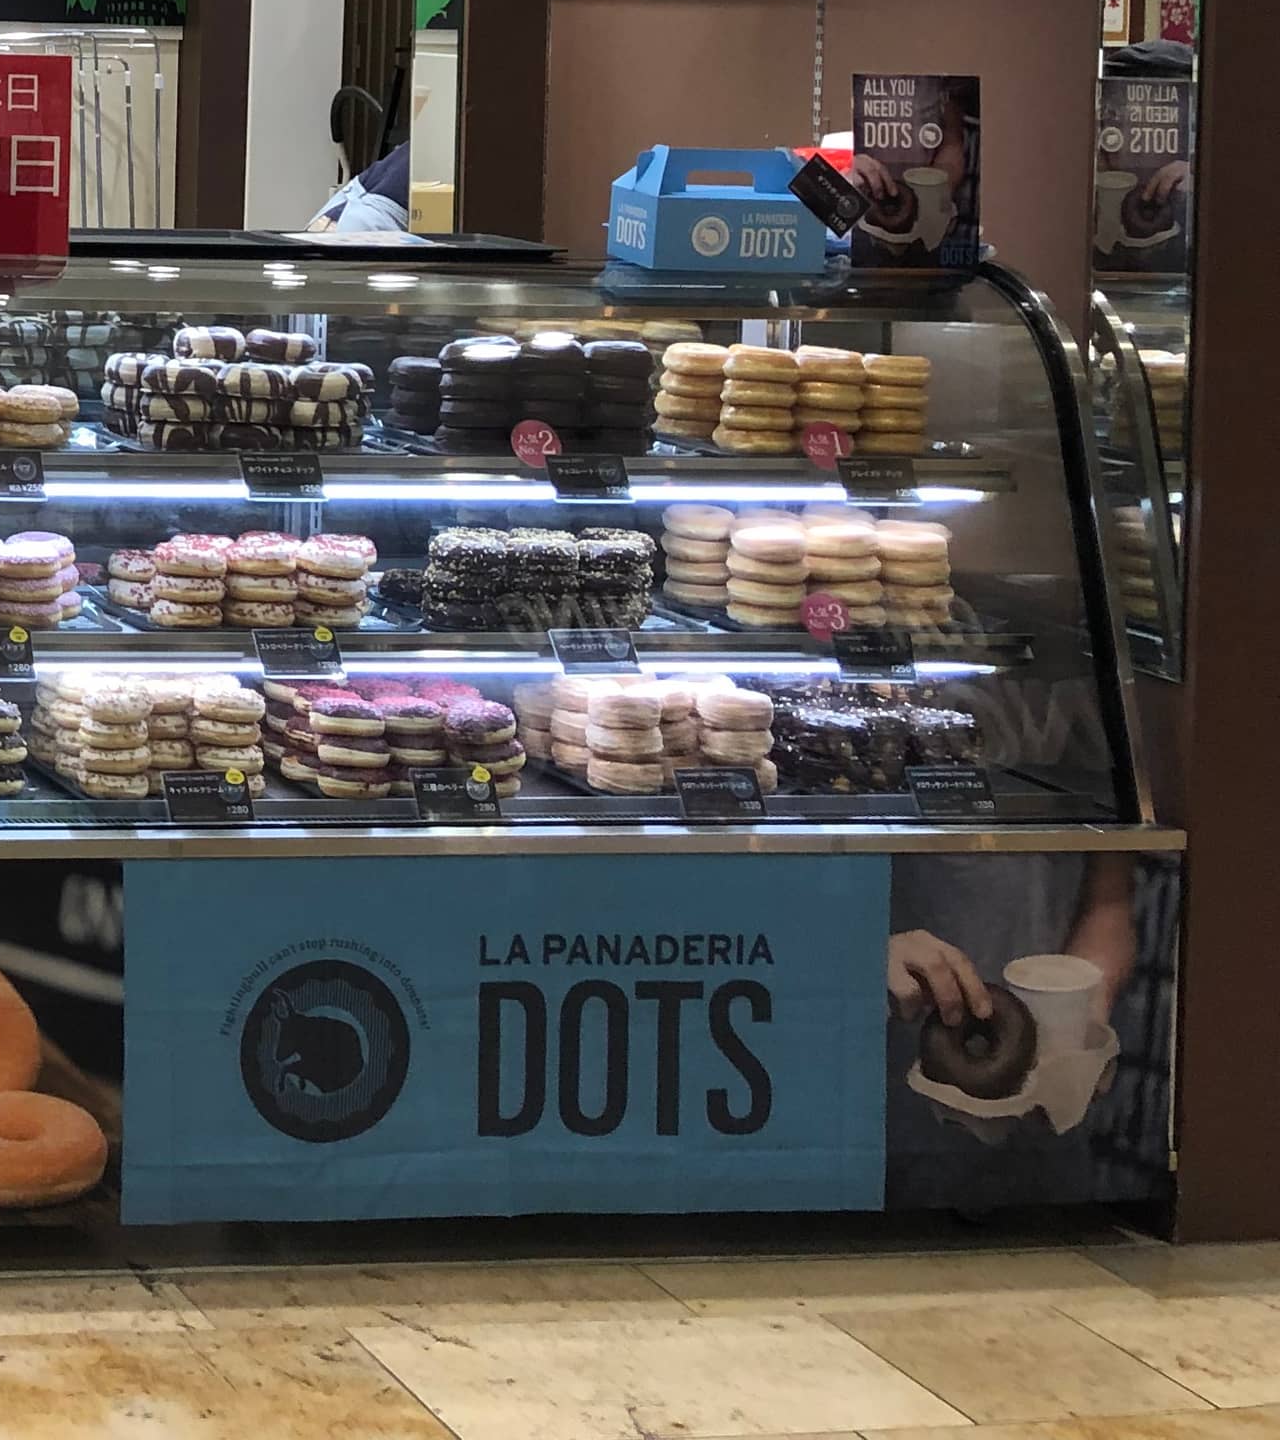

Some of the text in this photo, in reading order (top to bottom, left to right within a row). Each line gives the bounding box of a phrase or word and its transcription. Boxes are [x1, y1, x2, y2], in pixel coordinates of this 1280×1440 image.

[863, 79, 915, 97] ALL YOU
[863, 100, 913, 118] NEED IS
[863, 121, 913, 149] DOTS
[616, 215, 647, 250] DOTS
[740, 227, 797, 259] DOTS
[538, 430, 556, 455] 2
[830, 431, 843, 456] 1
[828, 603, 845, 630] 3
[299, 937, 327, 951] stop
[479, 933, 775, 966] LA PANADERIA
[477, 978, 772, 1138] DOTS
